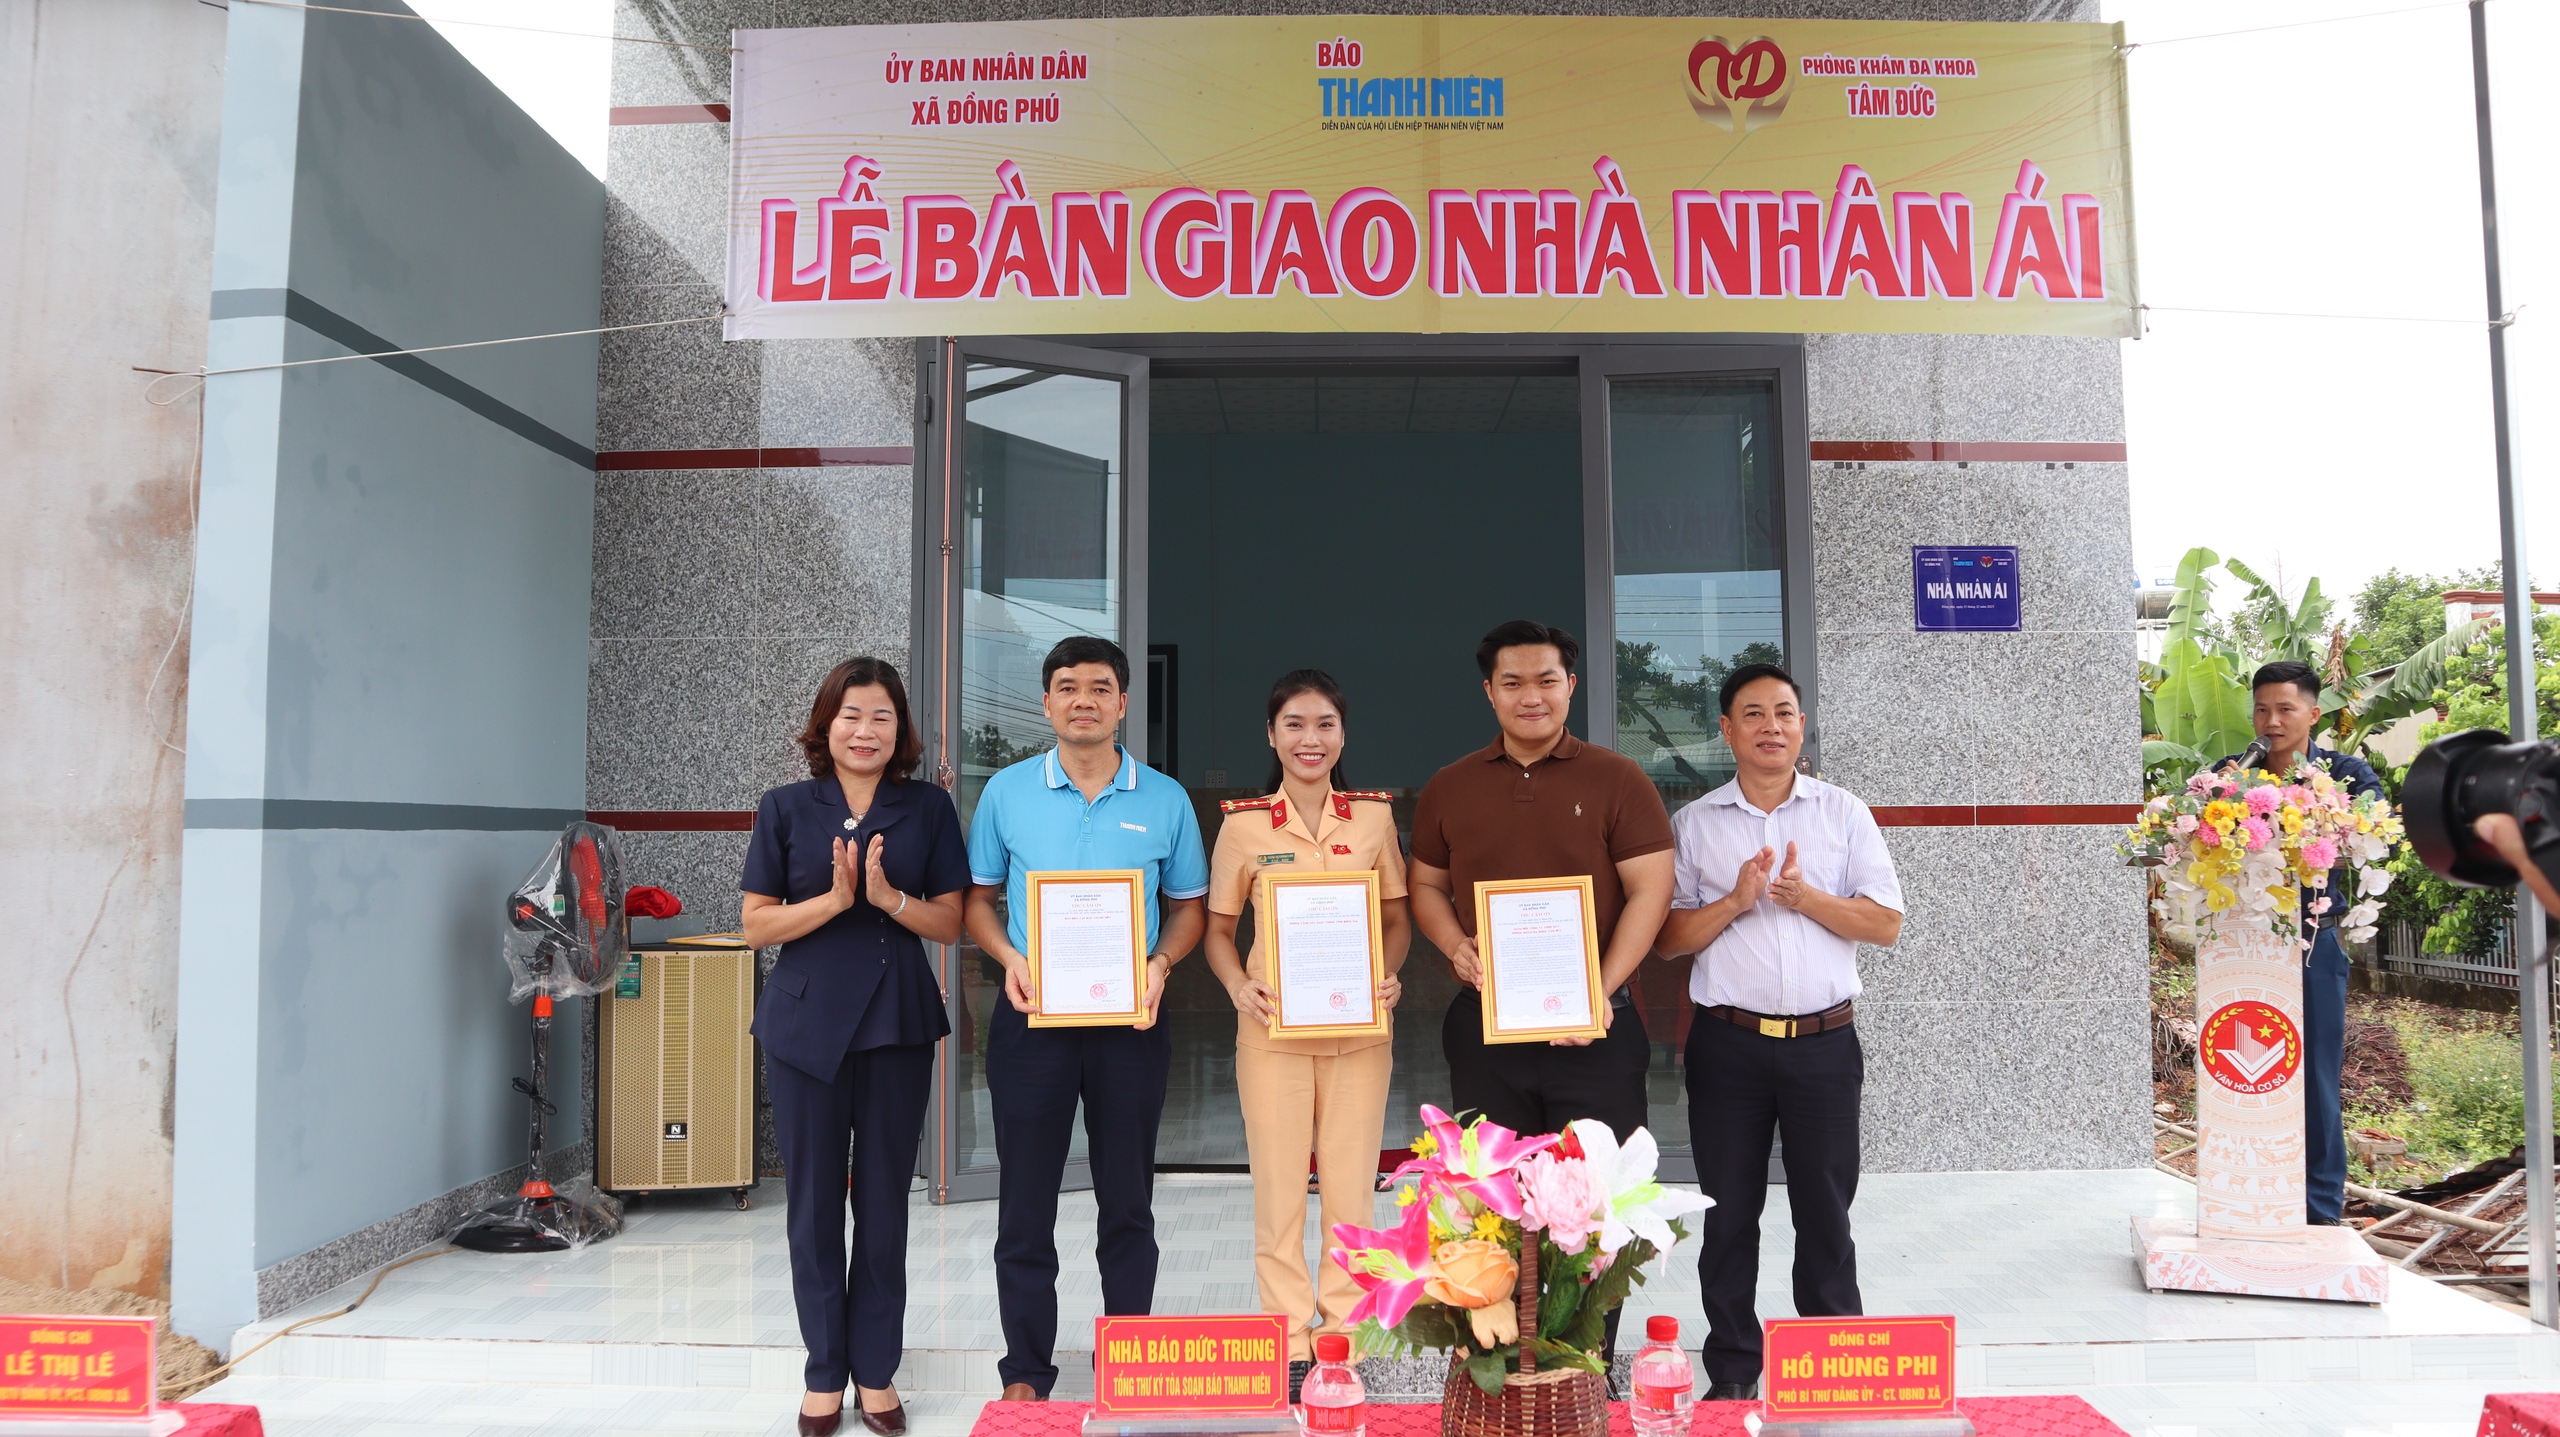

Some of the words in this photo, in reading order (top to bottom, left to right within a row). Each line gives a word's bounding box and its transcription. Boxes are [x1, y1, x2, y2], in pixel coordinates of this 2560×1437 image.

[1318, 37, 1361, 66] BÁO
[1803, 55, 1855, 74] PHÒNG
[1859, 56, 1905, 74] KHÁM
[1909, 60, 1930, 74] ĐA
[1935, 60, 1976, 75] KHOA
[886, 52, 913, 83] ỦY
[920, 59, 965, 82] BAN
[972, 52, 1034, 81] NHÂN
[1042, 50, 1086, 79] DÂN
[911, 96, 940, 125] XÃ
[947, 92, 1007, 124] ĐỒNG
[1015, 93, 1059, 122] PHÚ
[1318, 78, 1425, 116] THANH
[1431, 74, 1503, 117] NIÊN
[1848, 83, 1889, 115] TÂM
[1896, 84, 1934, 116] ĐỨC
[1322, 119, 1338, 130] DIỄN
[1340, 120, 1355, 130] ĐÀN
[1357, 119, 1372, 130] CỦA
[1374, 120, 1386, 132] HỘI
[1388, 120, 1403, 130] LIÊN
[1405, 120, 1422, 132] HIỆP
[1424, 122, 1449, 130] THANH
[1451, 120, 1467, 130] NIÊN
[1469, 120, 1485, 131] VIỆT
[1487, 122, 1503, 130] NAM
[760, 157, 892, 301] LỄ
[902, 161, 1129, 298] BÀN
[1141, 189, 1419, 298] GIAO
[1431, 157, 1667, 298] NHÀ
[1675, 167, 1976, 299] NHÂN
[1985, 161, 2103, 299] ÁI
[1926, 577, 1954, 599] NHÀ
[1956, 578, 1991, 599] NHÂN
[1993, 577, 2007, 599] ÁI
[2214, 1070, 2232, 1087] VĂN
[2233, 1081, 2256, 1092] HÓA
[2257, 1082, 2272, 1092] CƠ
[2272, 1072, 2287, 1087] SỞ
[1109, 1335, 1142, 1363] NHÀ
[1148, 1335, 1180, 1363] BÁO
[1184, 1334, 1217, 1362] ĐỨC
[1222, 1339, 1275, 1362] TRUNG
[1829, 1330, 1864, 1346] ĐỒNG
[1868, 1330, 1890, 1346] CHÍ
[41, 1354, 80, 1380] THỊ
[1782, 1351, 1814, 1378] HỒ
[1822, 1353, 1889, 1378] HÙNG
[1897, 1356, 1937, 1376] PHI
[1114, 1370, 1134, 1396] TỔNG
[1136, 1374, 1152, 1396] THƯ
[1153, 1373, 1164, 1396] KÝ
[1166, 1372, 1180, 1396] TÒA
[1182, 1376, 1204, 1400] SOẠN
[1206, 1372, 1222, 1396] BÁO
[1224, 1376, 1250, 1395] THANH
[1252, 1372, 1270, 1395] NIÊN
[1777, 1388, 1796, 1403] PHÓ
[1800, 1388, 1810, 1402] BÍ
[1812, 1388, 1832, 1402] THƯ
[1832, 1386, 1859, 1402] ĐẢNG
[1862, 1385, 1874, 1402] ỦY
[1883, 1388, 1896, 1401] CT.
[1898, 1388, 1925, 1400] UBND
[1928, 1385, 1941, 1400] XÃ
